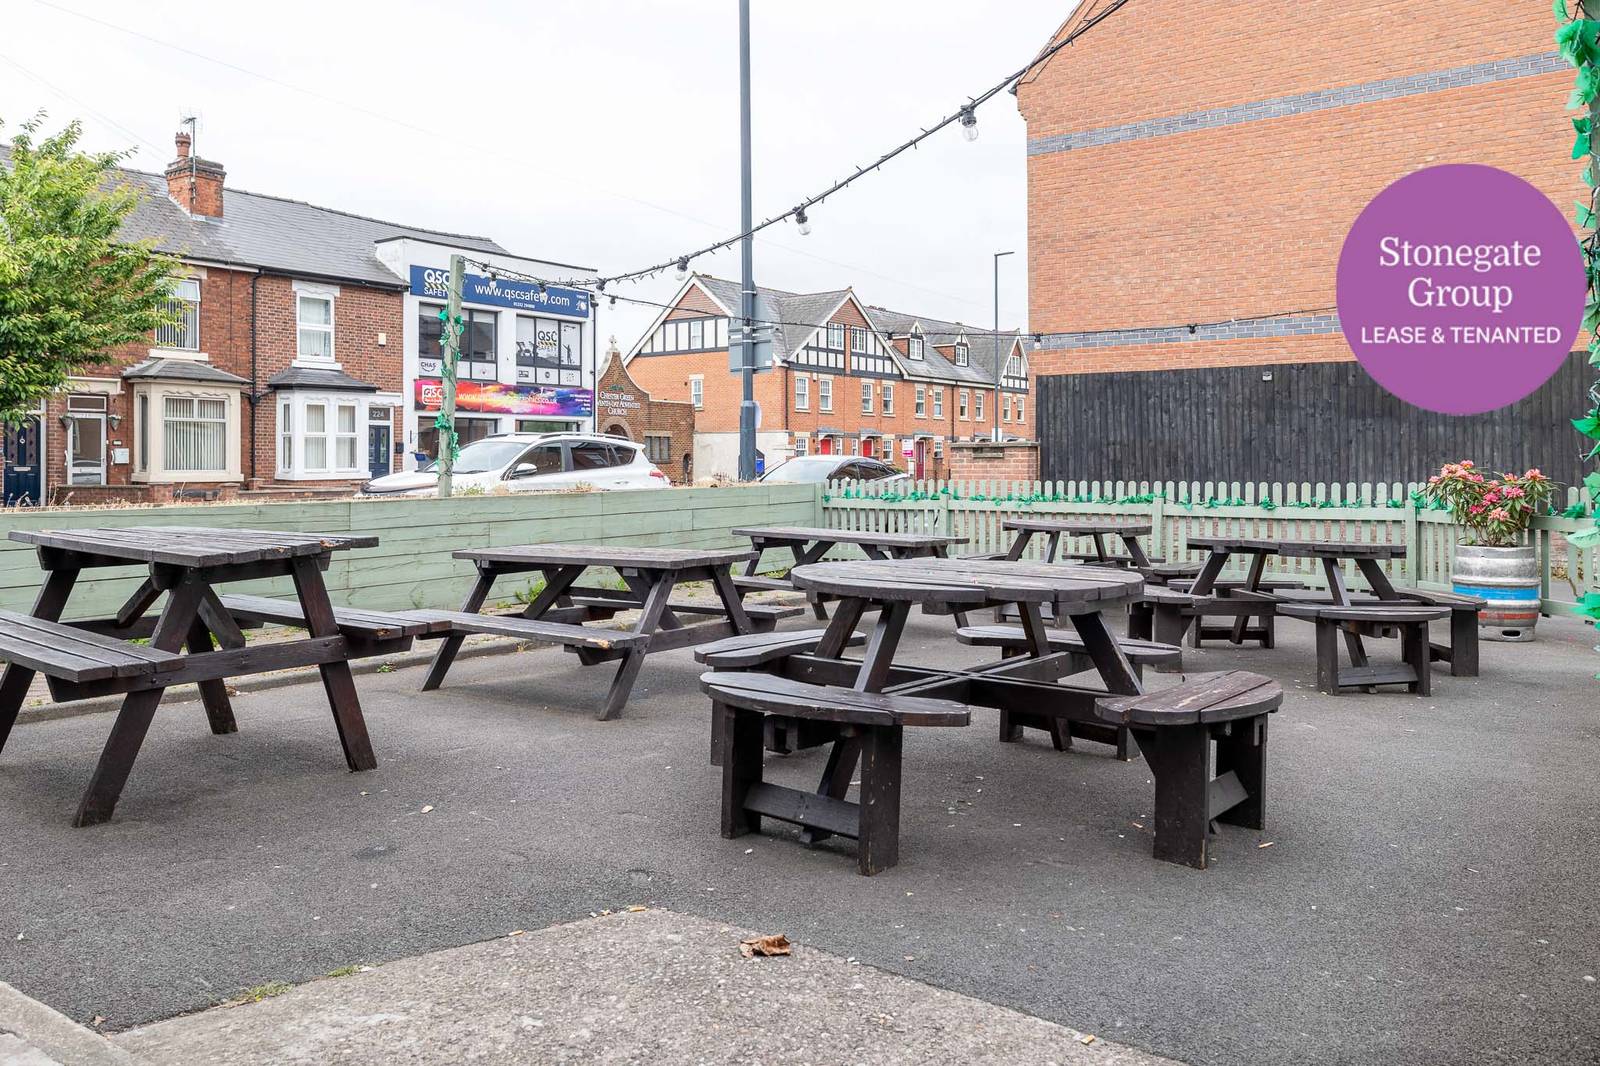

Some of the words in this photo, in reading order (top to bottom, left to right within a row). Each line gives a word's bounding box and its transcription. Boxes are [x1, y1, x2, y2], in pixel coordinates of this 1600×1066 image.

[424, 269, 449, 285] QSC
[474, 283, 571, 306] www.qscsafety.com
[537, 330, 557, 343] QSC
[421, 361, 437, 369] CHAS
[372, 408, 384, 417] 224
